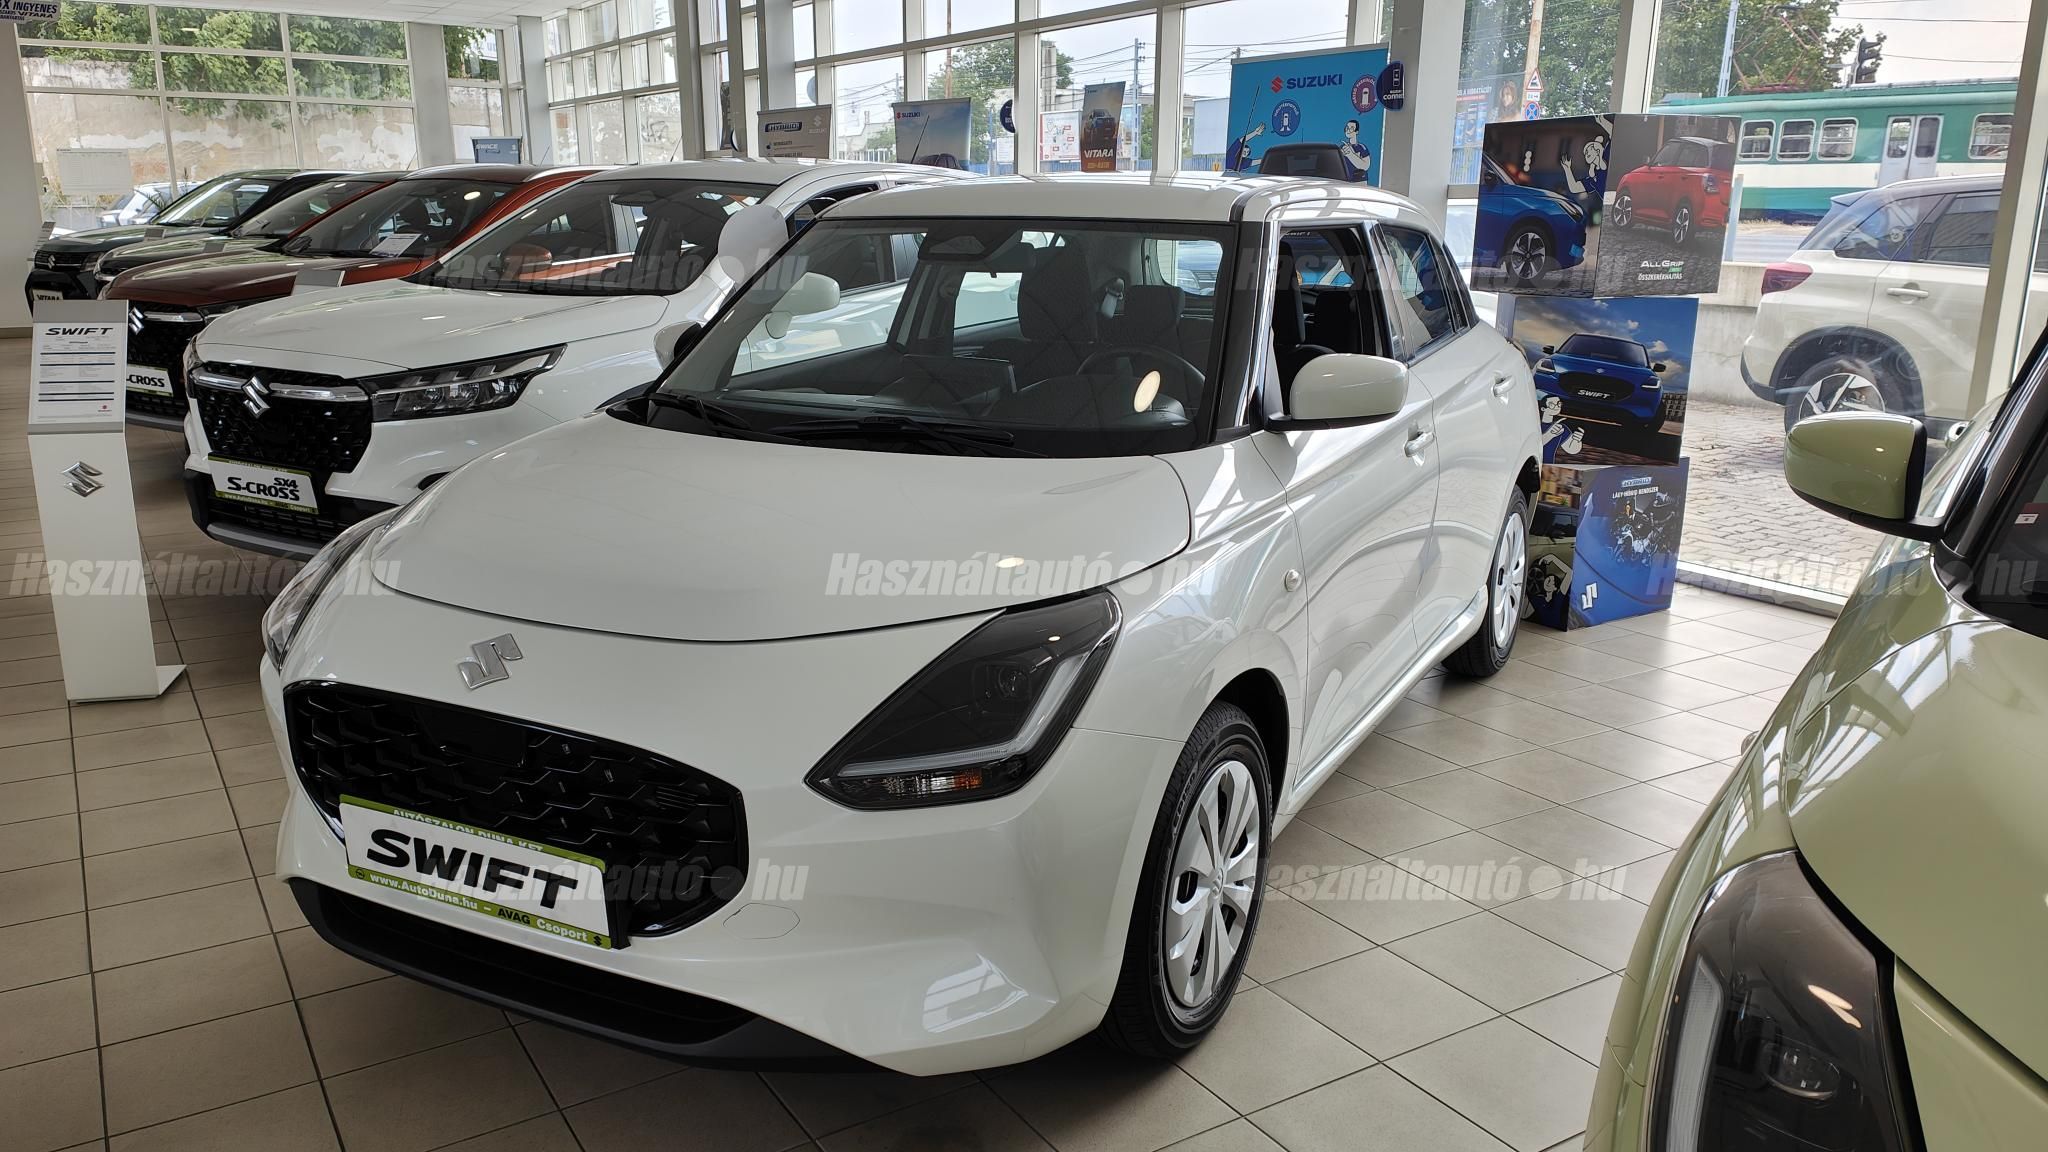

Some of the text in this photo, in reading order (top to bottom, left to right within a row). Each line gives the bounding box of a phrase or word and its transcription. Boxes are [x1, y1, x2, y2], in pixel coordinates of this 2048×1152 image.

[13, 1, 58, 14] INGYENES
[1286, 73, 1343, 90] SUZUKI
[1084, 149, 1114, 158] VITARA
[45, 327, 114, 336] SWIFT
[126, 374, 166, 388] -CROSS
[1577, 389, 1611, 399] SWIFT
[227, 476, 300, 501] S-CROSS
[273, 477, 299, 489] SX4
[366, 828, 579, 910] SWIFT
[369, 873, 589, 942] www.AutoDuna.hu AVAG Csoport
